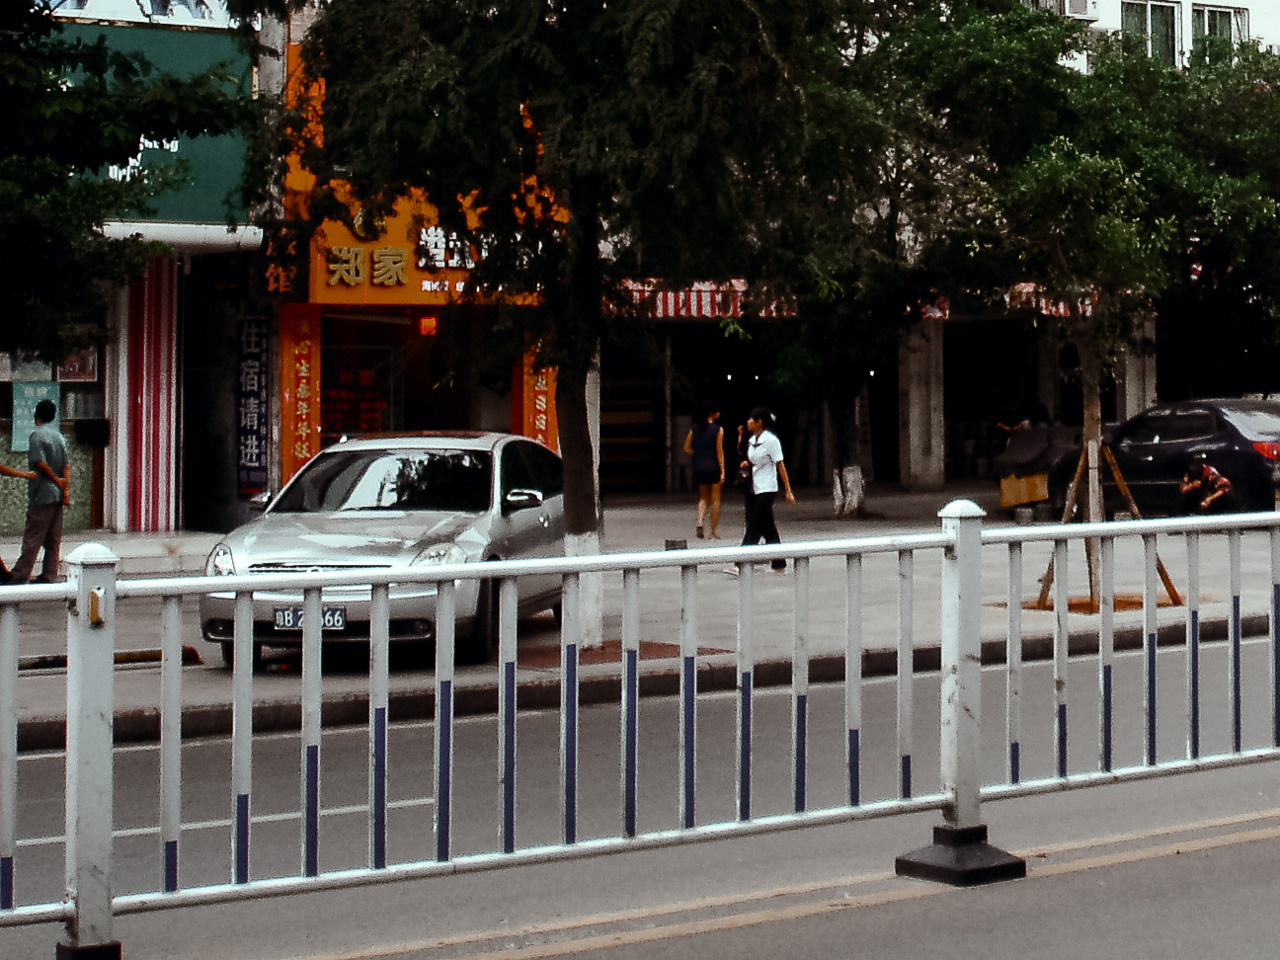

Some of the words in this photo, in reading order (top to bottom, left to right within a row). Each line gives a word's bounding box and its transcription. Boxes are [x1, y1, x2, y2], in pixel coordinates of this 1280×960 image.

[328, 246, 408, 286] 郑家
[239, 321, 260, 467] 住宿请进
